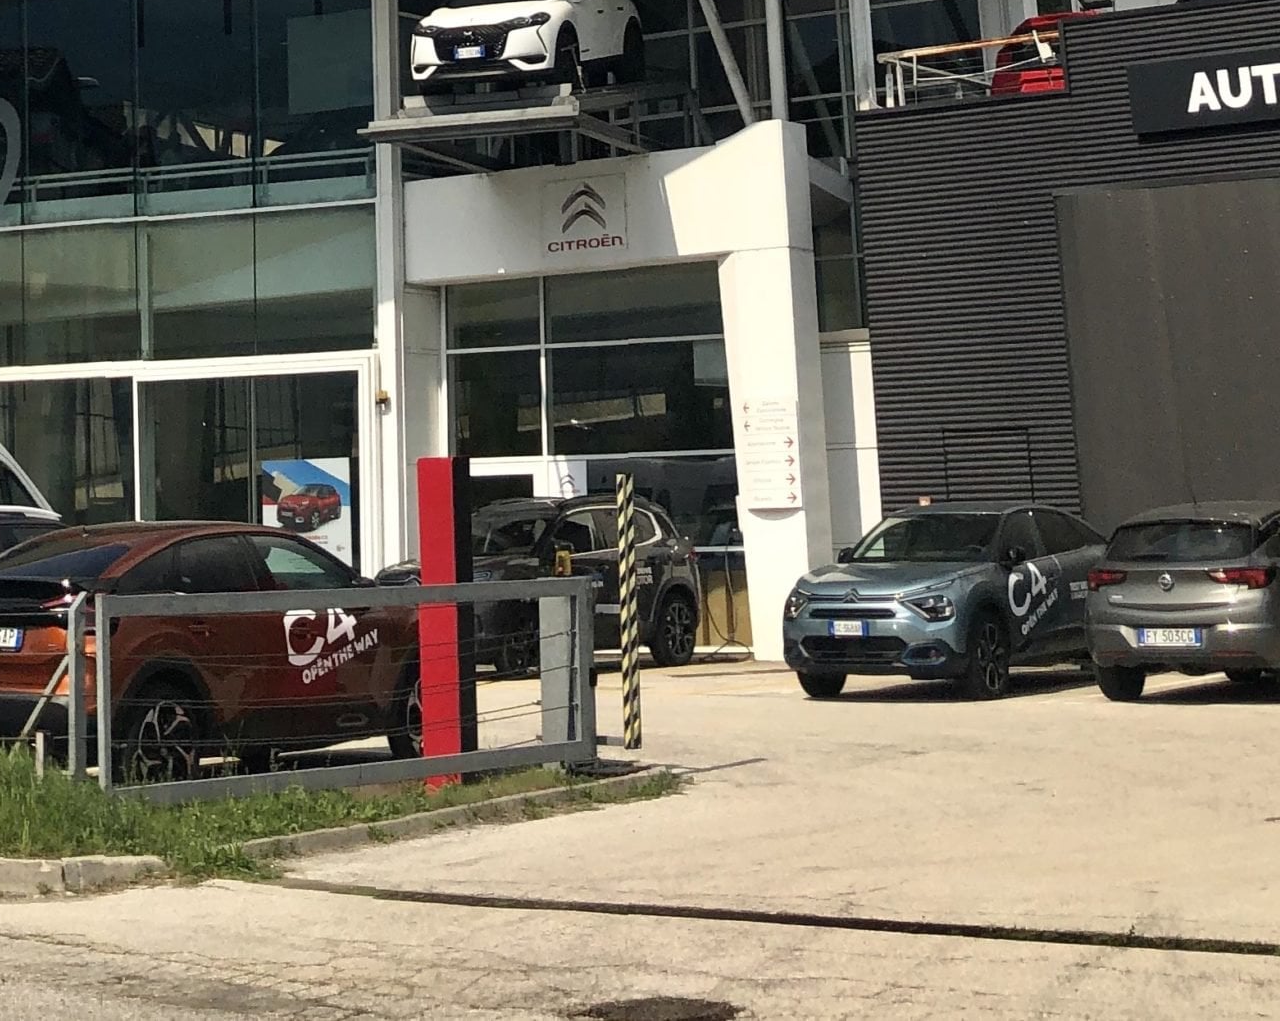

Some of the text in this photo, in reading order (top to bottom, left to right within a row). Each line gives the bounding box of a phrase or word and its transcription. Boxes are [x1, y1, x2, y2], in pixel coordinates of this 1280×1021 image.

[547, 233, 624, 253] CITROËN
[1008, 562, 1047, 616] C4
[283, 608, 357, 666] C4
[302, 628, 378, 684] OPEN THE WAY
